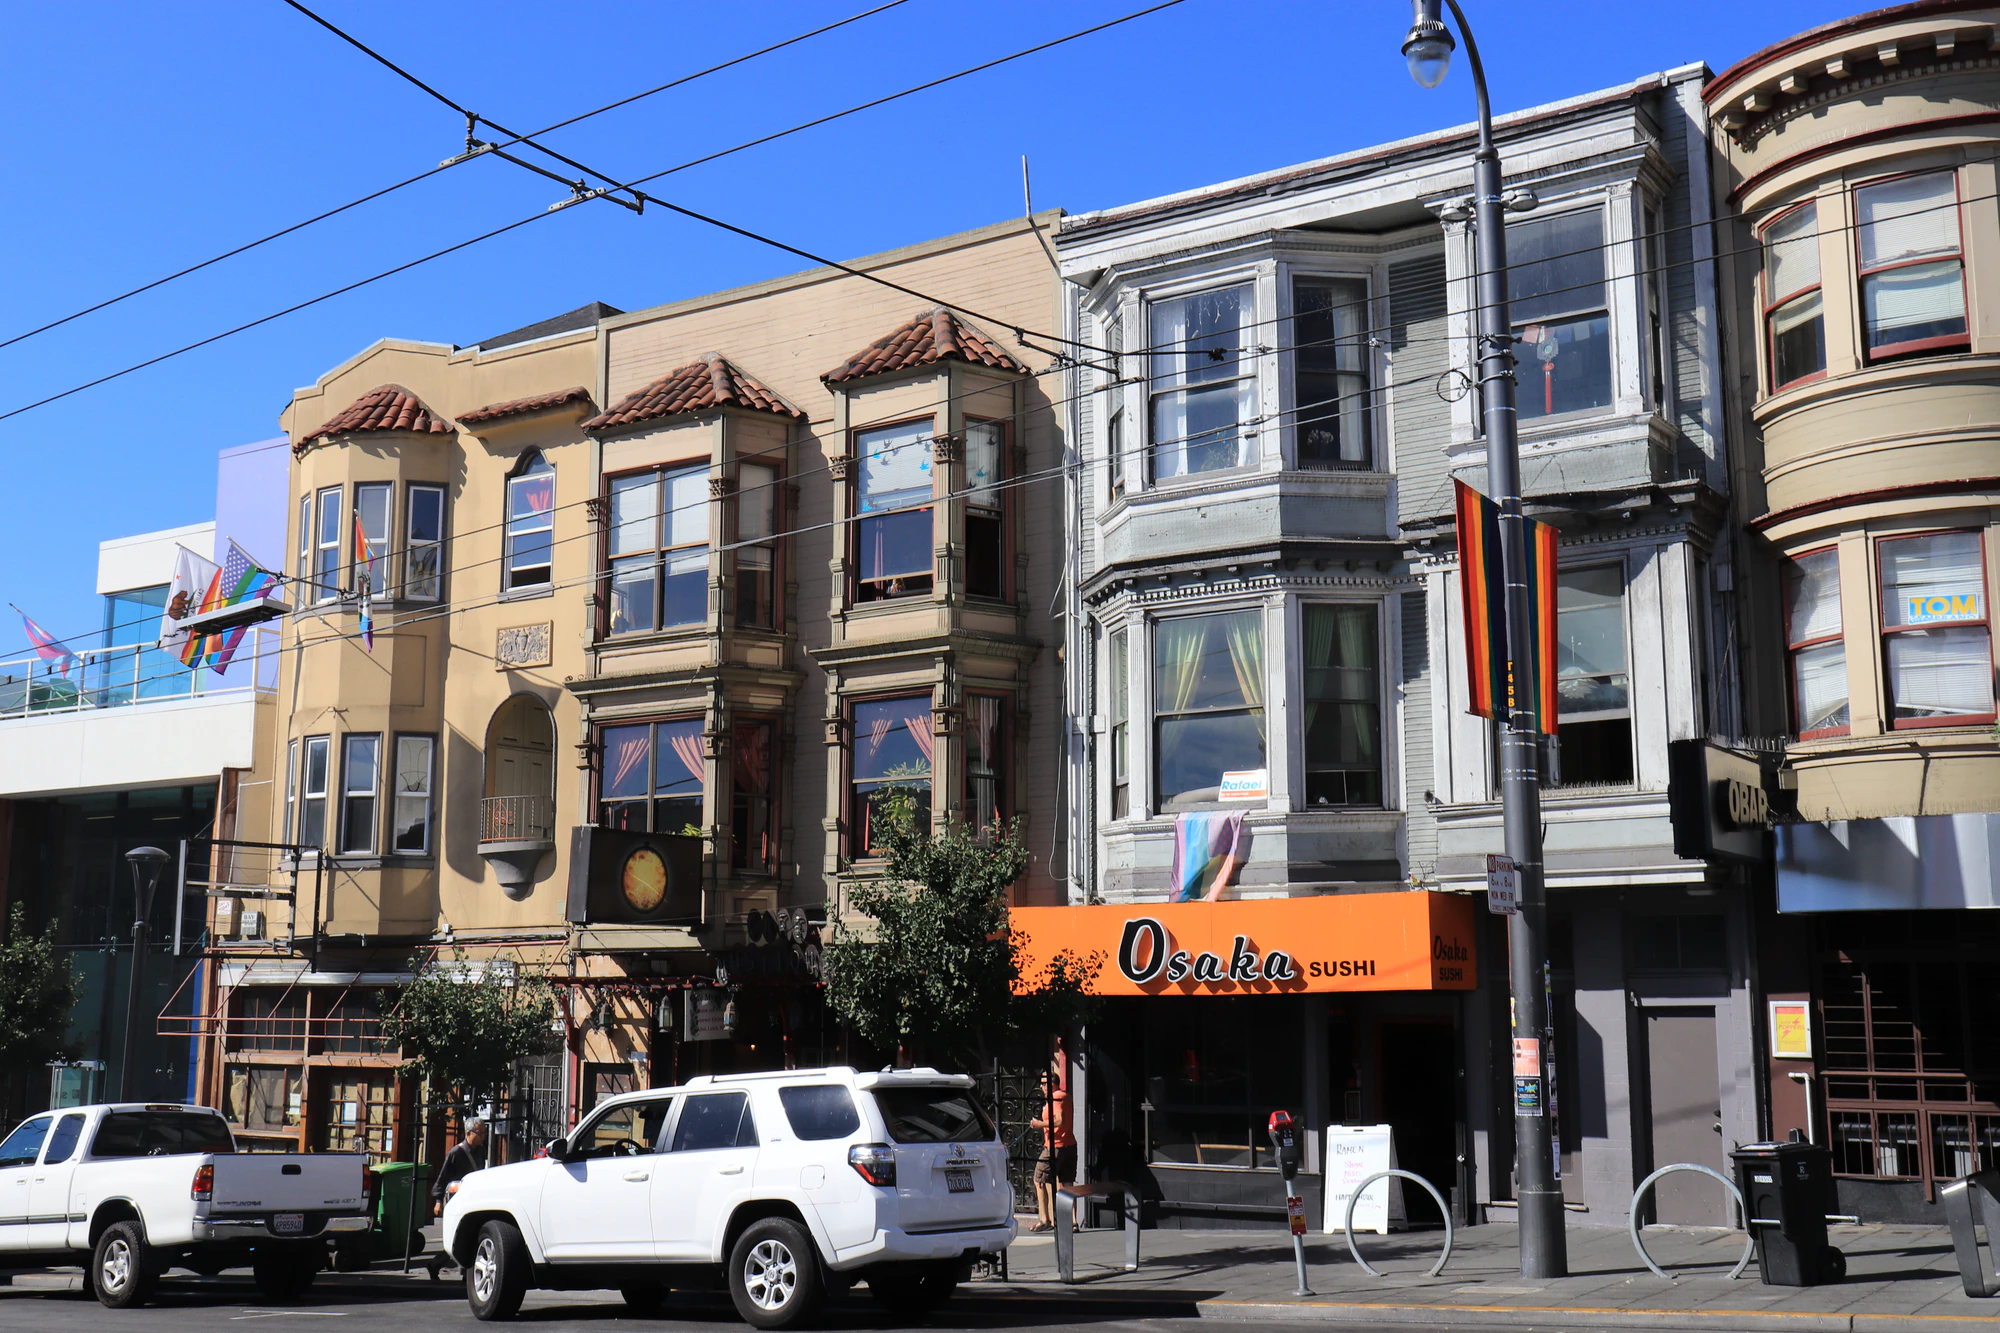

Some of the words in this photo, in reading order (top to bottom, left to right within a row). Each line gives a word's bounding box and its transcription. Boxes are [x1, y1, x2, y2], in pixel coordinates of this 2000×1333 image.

[1911, 594, 1977, 615] TOM
[1221, 780, 1263, 790] Rafael
[1497, 860, 1513, 873] PARKING
[1118, 917, 1298, 984] Osaka
[1309, 960, 1376, 977] SUSHI
[1433, 935, 1469, 962] Osaka
[1439, 967, 1463, 981] SUSHI
[1336, 1143, 1365, 1155] RAMEN
[275, 1220, 302, 1231] 6P85940
